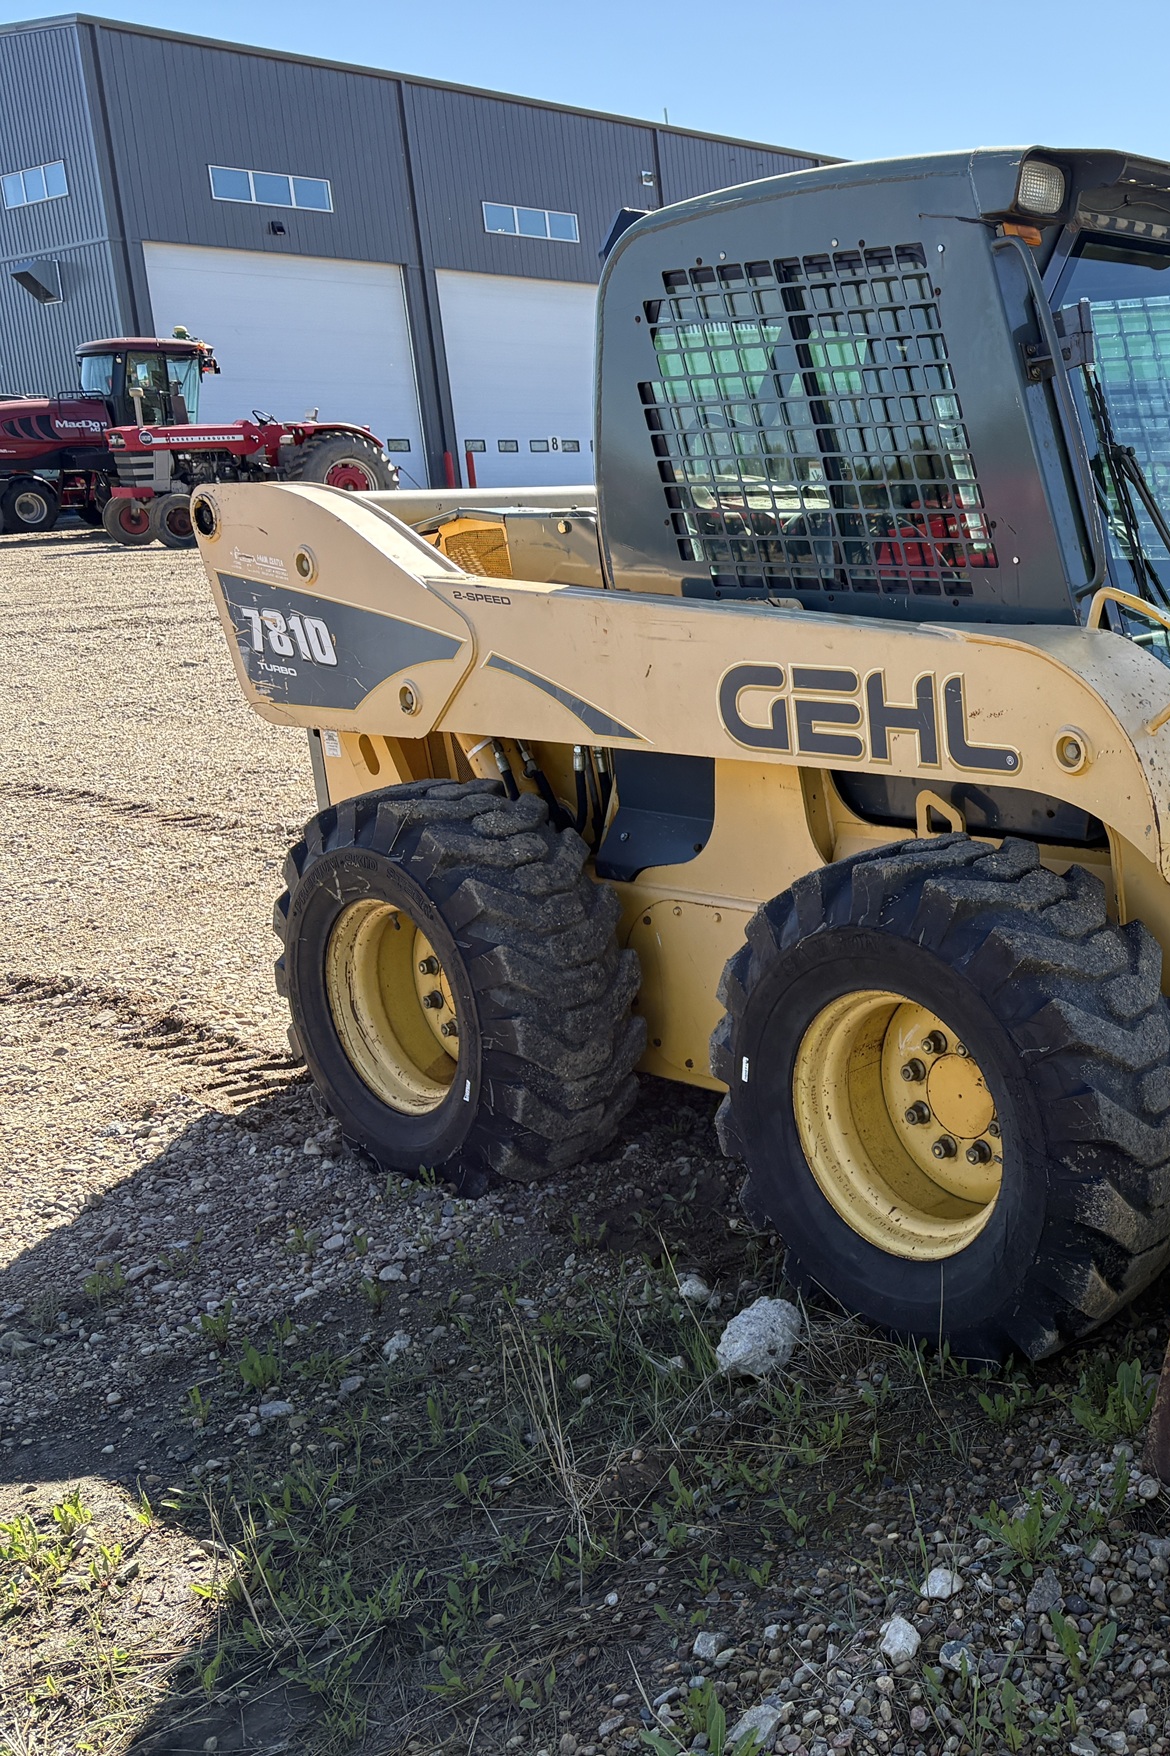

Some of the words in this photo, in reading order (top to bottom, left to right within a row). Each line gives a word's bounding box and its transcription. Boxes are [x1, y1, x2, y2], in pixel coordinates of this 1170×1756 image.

[55, 419, 107, 428] MacDon
[551, 436, 559, 450] 8
[452, 590, 511, 606] 2-SPEED
[241, 606, 338, 667] 7810
[257, 661, 297, 677] TURBO
[716, 660, 1023, 776] GEHL
